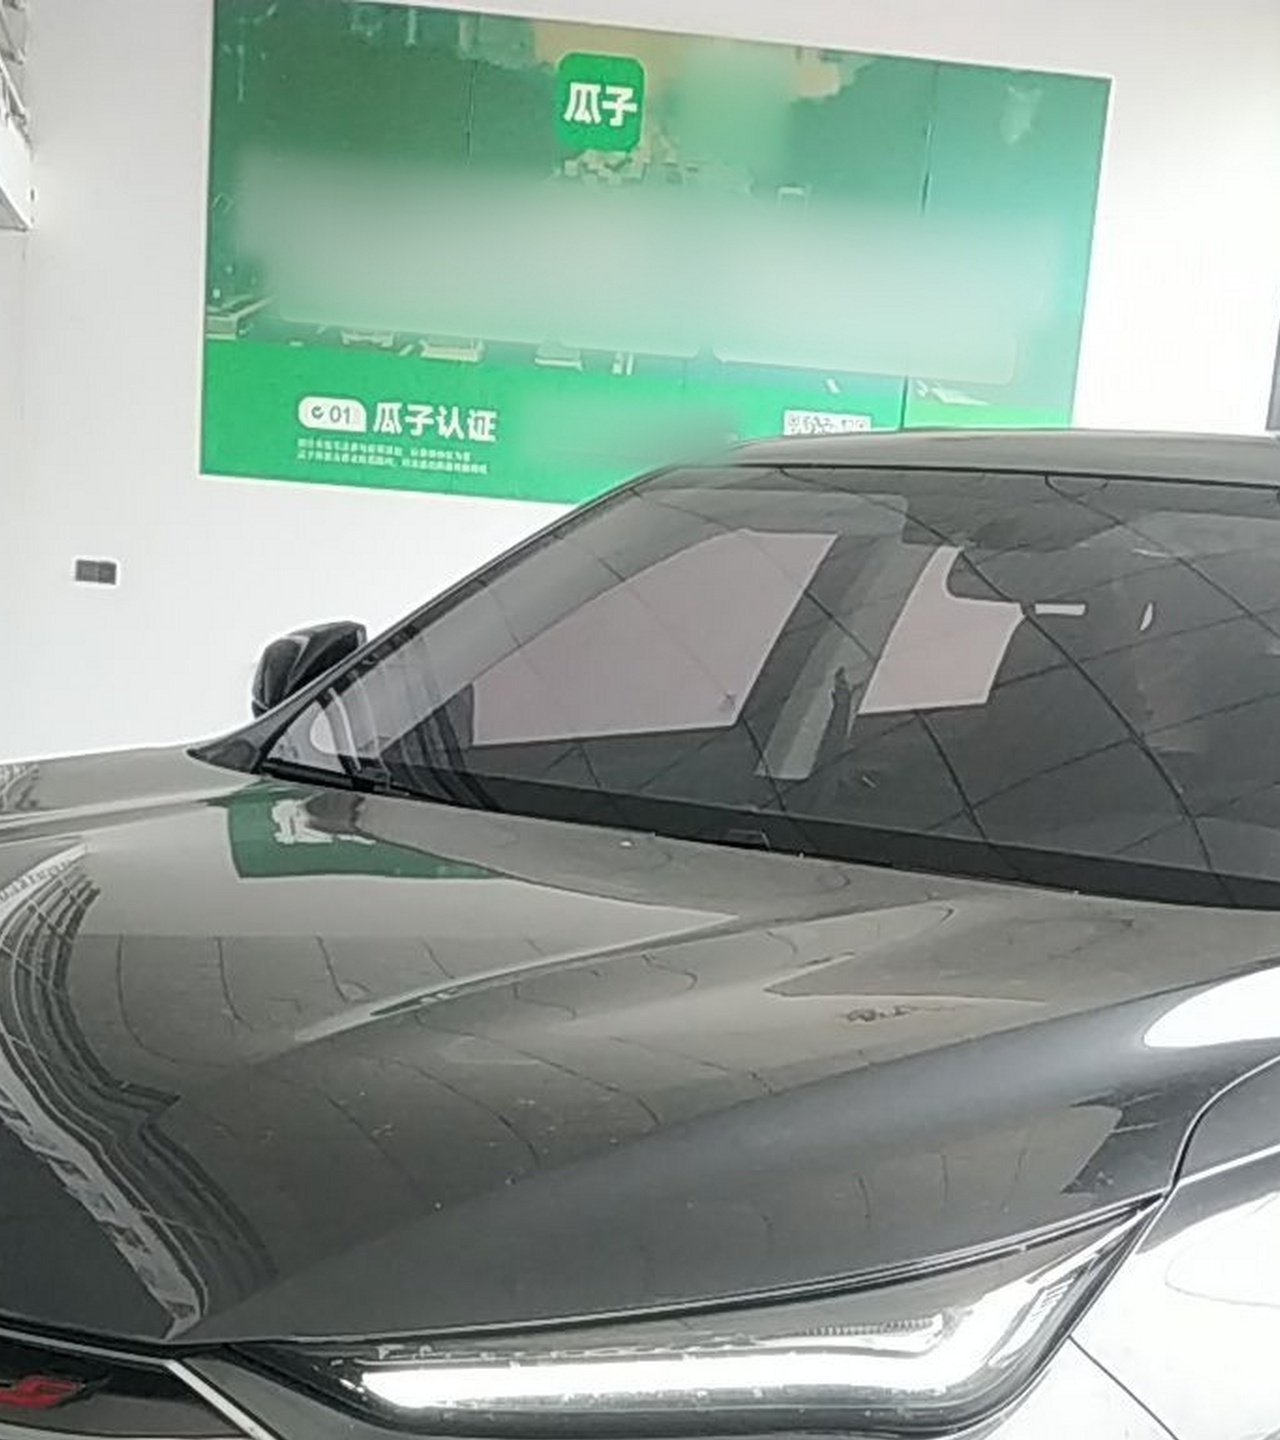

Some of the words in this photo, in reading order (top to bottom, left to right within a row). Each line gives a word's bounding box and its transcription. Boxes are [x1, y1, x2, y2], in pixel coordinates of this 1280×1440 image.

[563, 82, 638, 126] 瓜子
[373, 402, 497, 442] 瓜子认证
